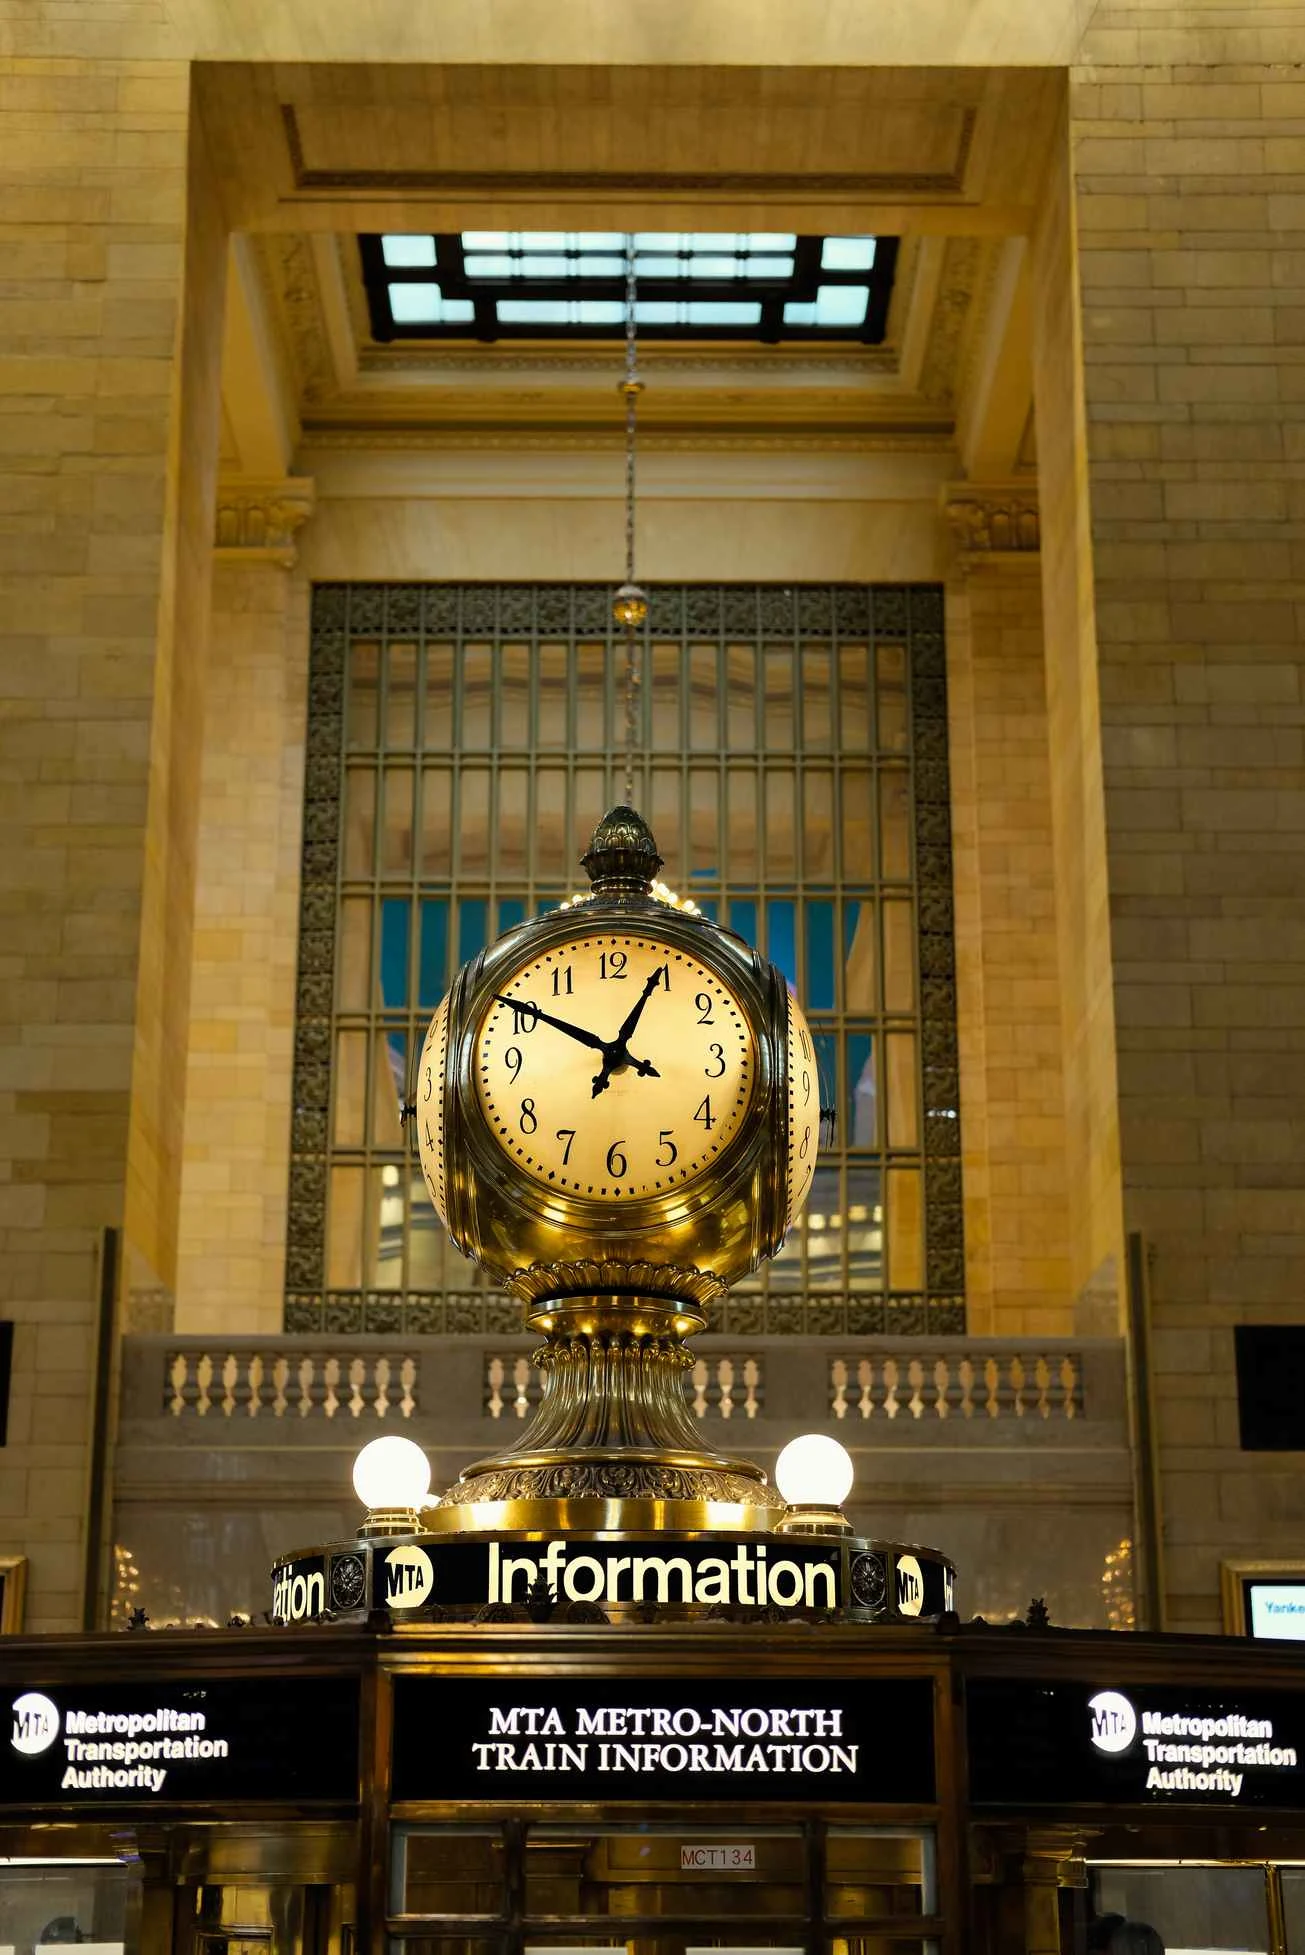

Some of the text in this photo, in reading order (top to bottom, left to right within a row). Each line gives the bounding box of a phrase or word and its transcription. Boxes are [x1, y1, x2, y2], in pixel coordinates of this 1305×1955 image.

[551, 965, 574, 997] 11
[599, 951, 628, 980] 12
[512, 1000, 538, 1035] 10
[695, 992, 714, 1025] 2
[505, 1046, 523, 1084] 9
[704, 1043, 726, 1078] 3
[423, 1066, 433, 1102] 3
[802, 1070, 811, 1107] 9
[519, 1098, 538, 1134] 8
[693, 1094, 717, 1130] 4
[424, 1119, 434, 1153] 4
[557, 1130, 577, 1166] 7
[655, 1131, 678, 1167] 5
[799, 1126, 811, 1160] 8
[606, 1140, 628, 1178] 6
[385, 1561, 425, 1598] MTA
[488, 1541, 836, 1608] Information
[65, 1708, 206, 1737] Metropolitan
[488, 1707, 843, 1738] MTA METRO-NORTH
[1142, 1711, 1273, 1742] Metropolitan
[63, 1735, 229, 1766] Transportation
[471, 1742, 859, 1773] TRAIN INFORMATION
[1142, 1738, 1297, 1768] Transportation
[61, 1764, 167, 1792] Authority
[1146, 1766, 1244, 1797] Authority
[682, 1848, 753, 1866] MCT134
